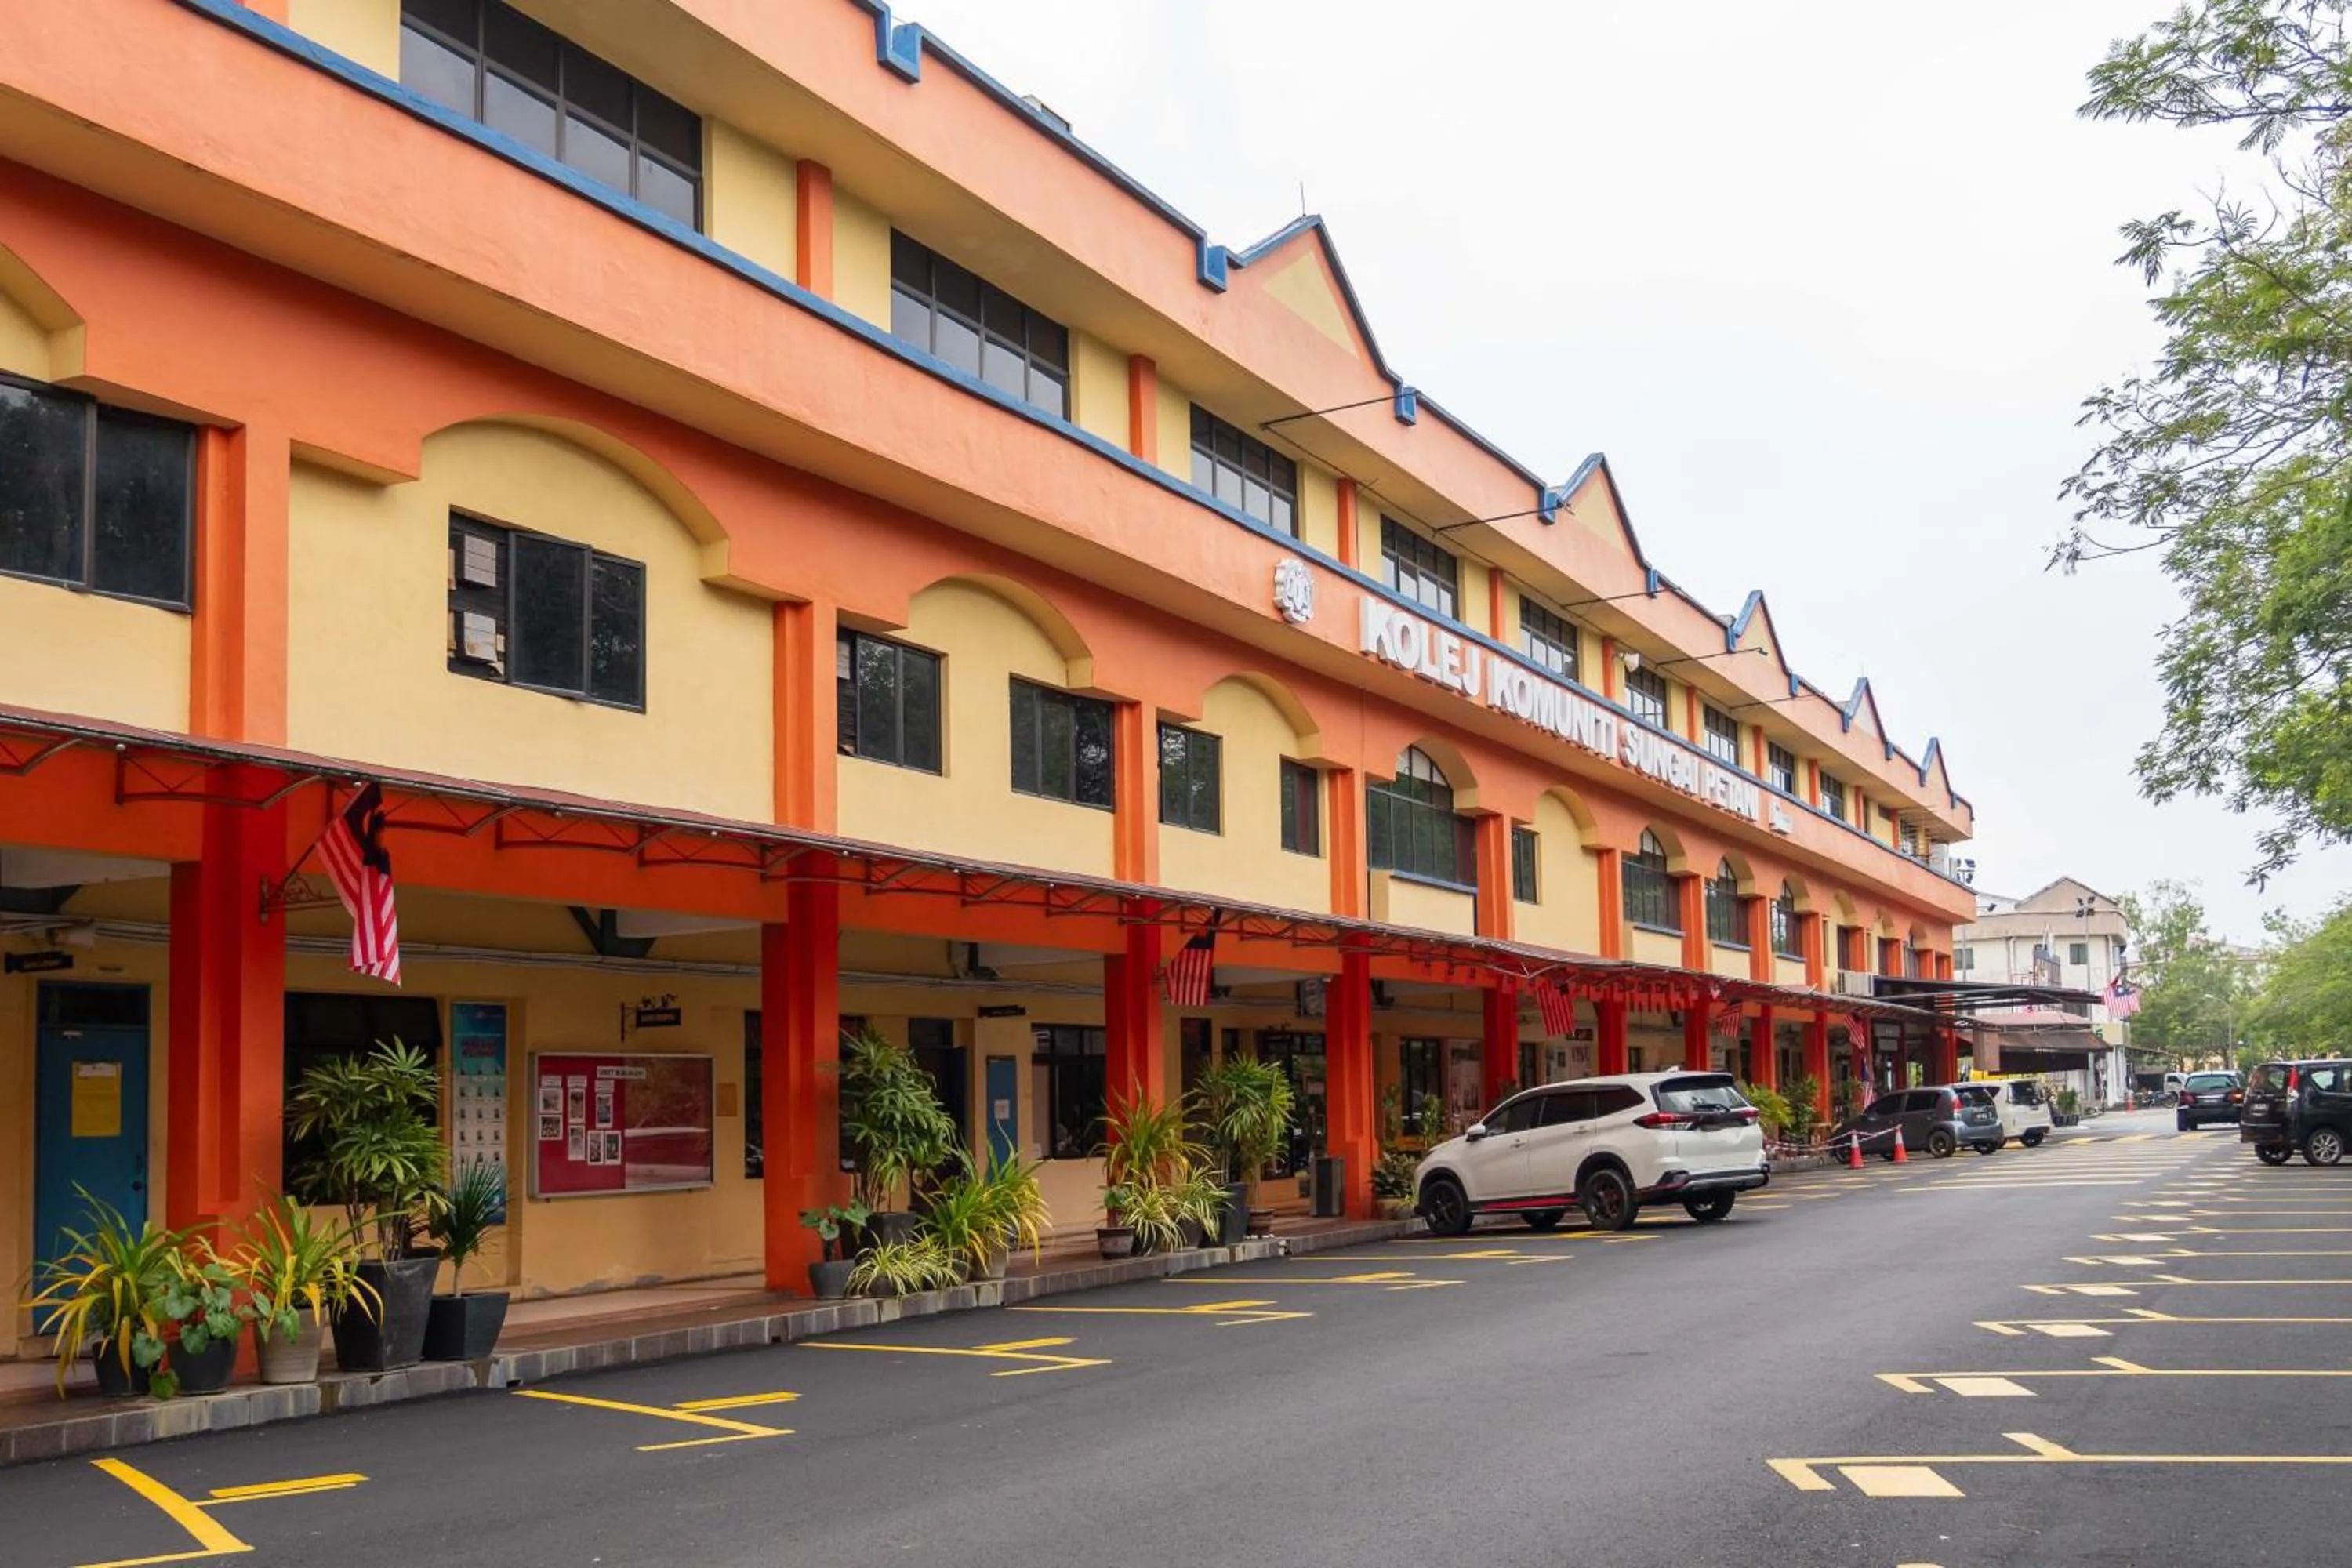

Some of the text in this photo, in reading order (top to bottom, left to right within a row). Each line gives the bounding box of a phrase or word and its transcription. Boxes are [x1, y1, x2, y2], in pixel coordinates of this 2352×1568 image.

[1359, 595, 1759, 822] KOLEJ KOMUNITI SUNGAI PETANI
